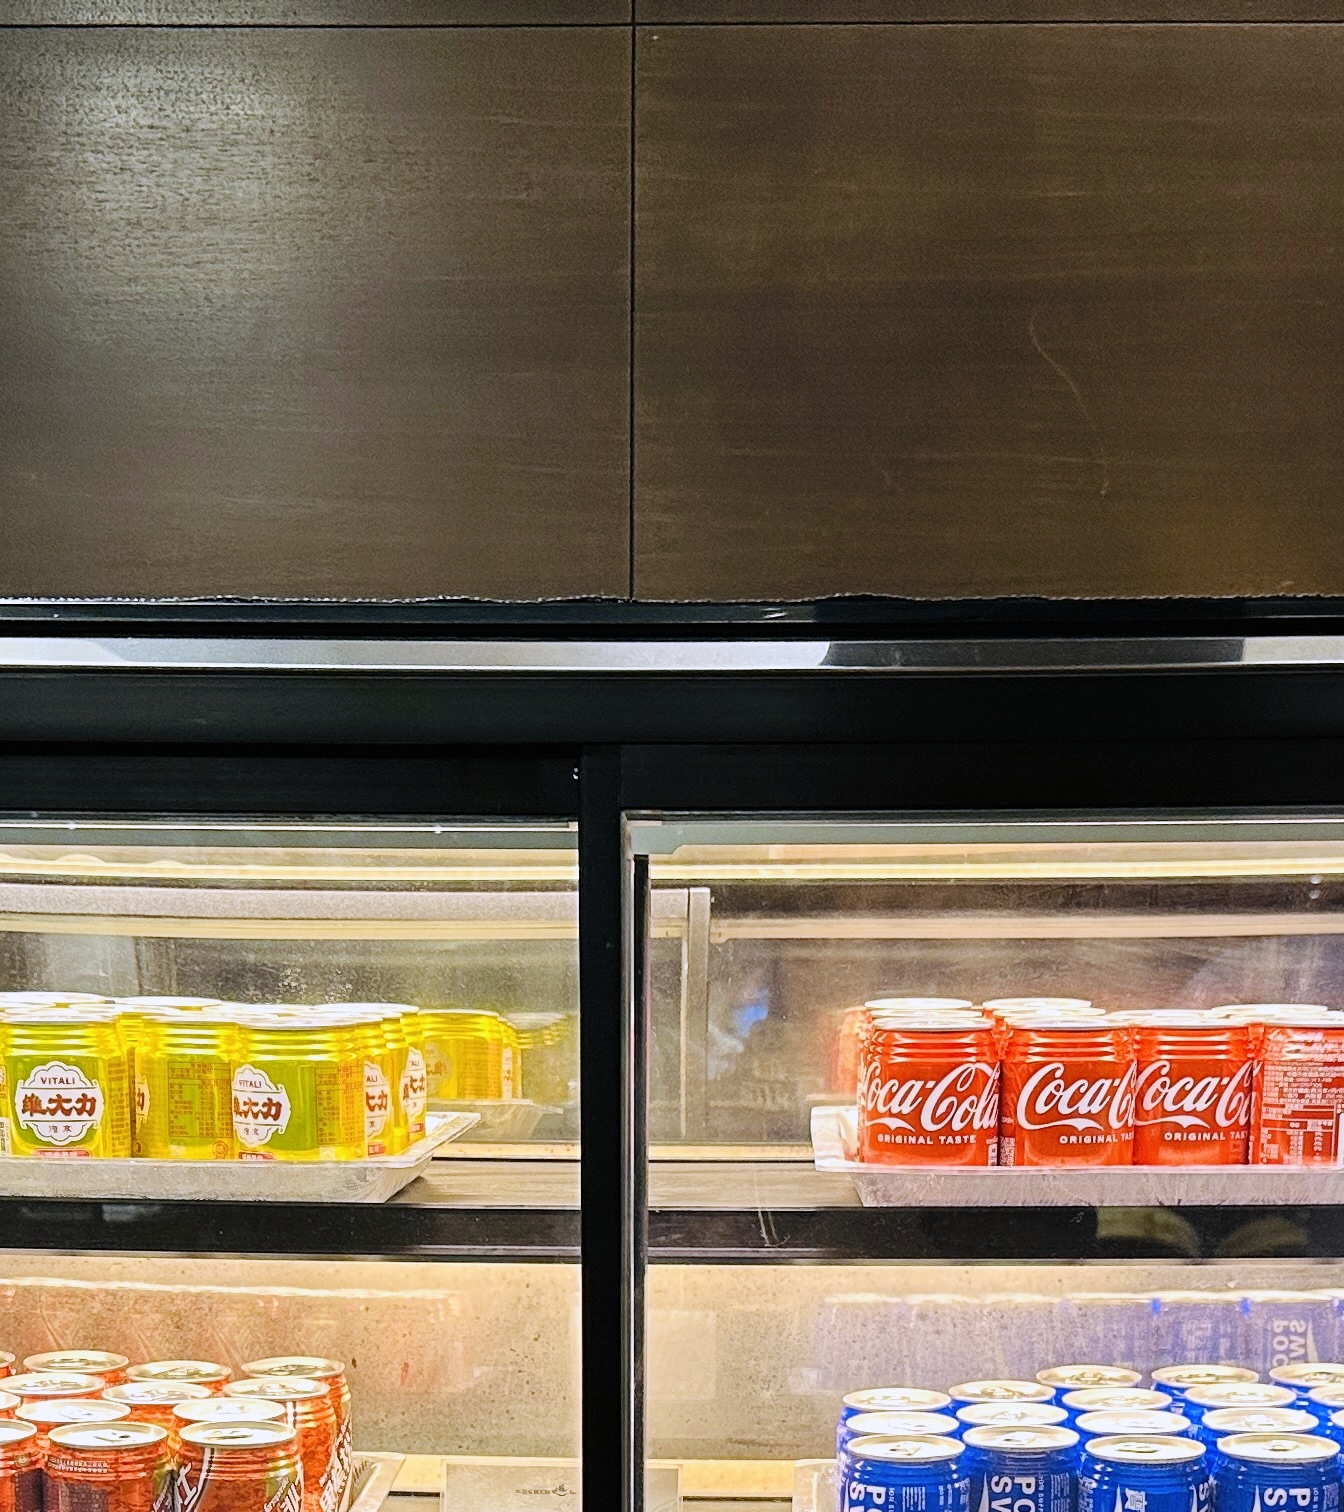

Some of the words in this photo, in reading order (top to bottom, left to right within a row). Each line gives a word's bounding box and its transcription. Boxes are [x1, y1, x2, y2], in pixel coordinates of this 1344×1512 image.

[40, 1076, 76, 1086] VITALI
[21, 1093, 98, 1117] 維大力
[877, 1134, 934, 1145] ORIGINAL
[938, 1134, 977, 1145] TASTE
[1059, 1134, 1118, 1145] ORIGINAL
[1164, 1131, 1226, 1142] ORIGINAL
